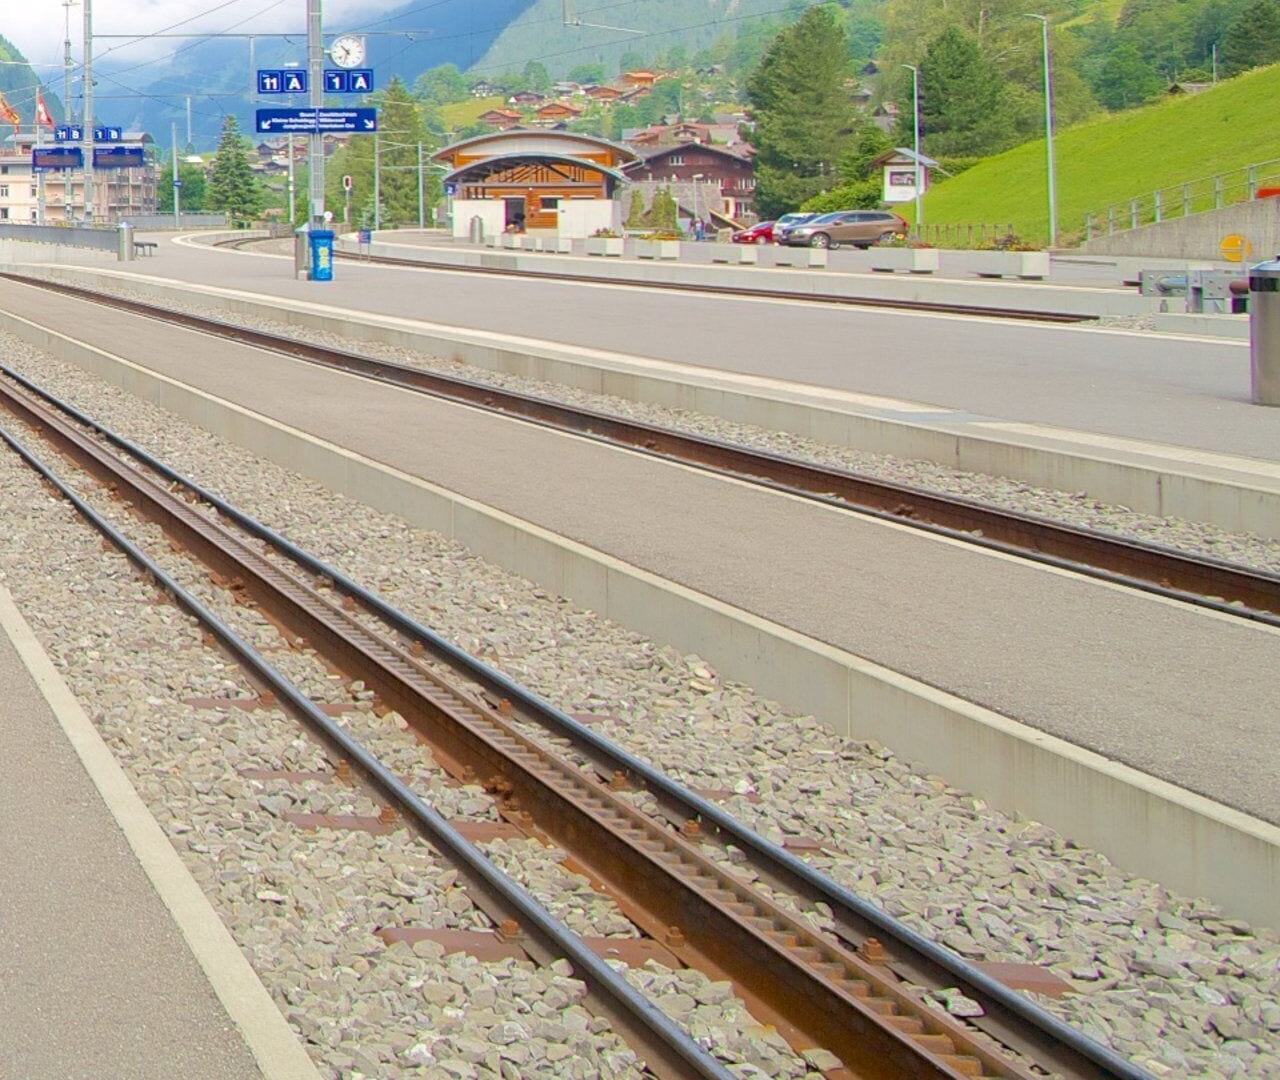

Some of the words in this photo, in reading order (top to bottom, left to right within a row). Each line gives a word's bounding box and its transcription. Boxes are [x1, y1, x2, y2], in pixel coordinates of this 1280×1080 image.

[263, 78, 278, 90] 11
[289, 78, 302, 90] A
[332, 77, 340, 89] 1
[355, 77, 368, 89] A
